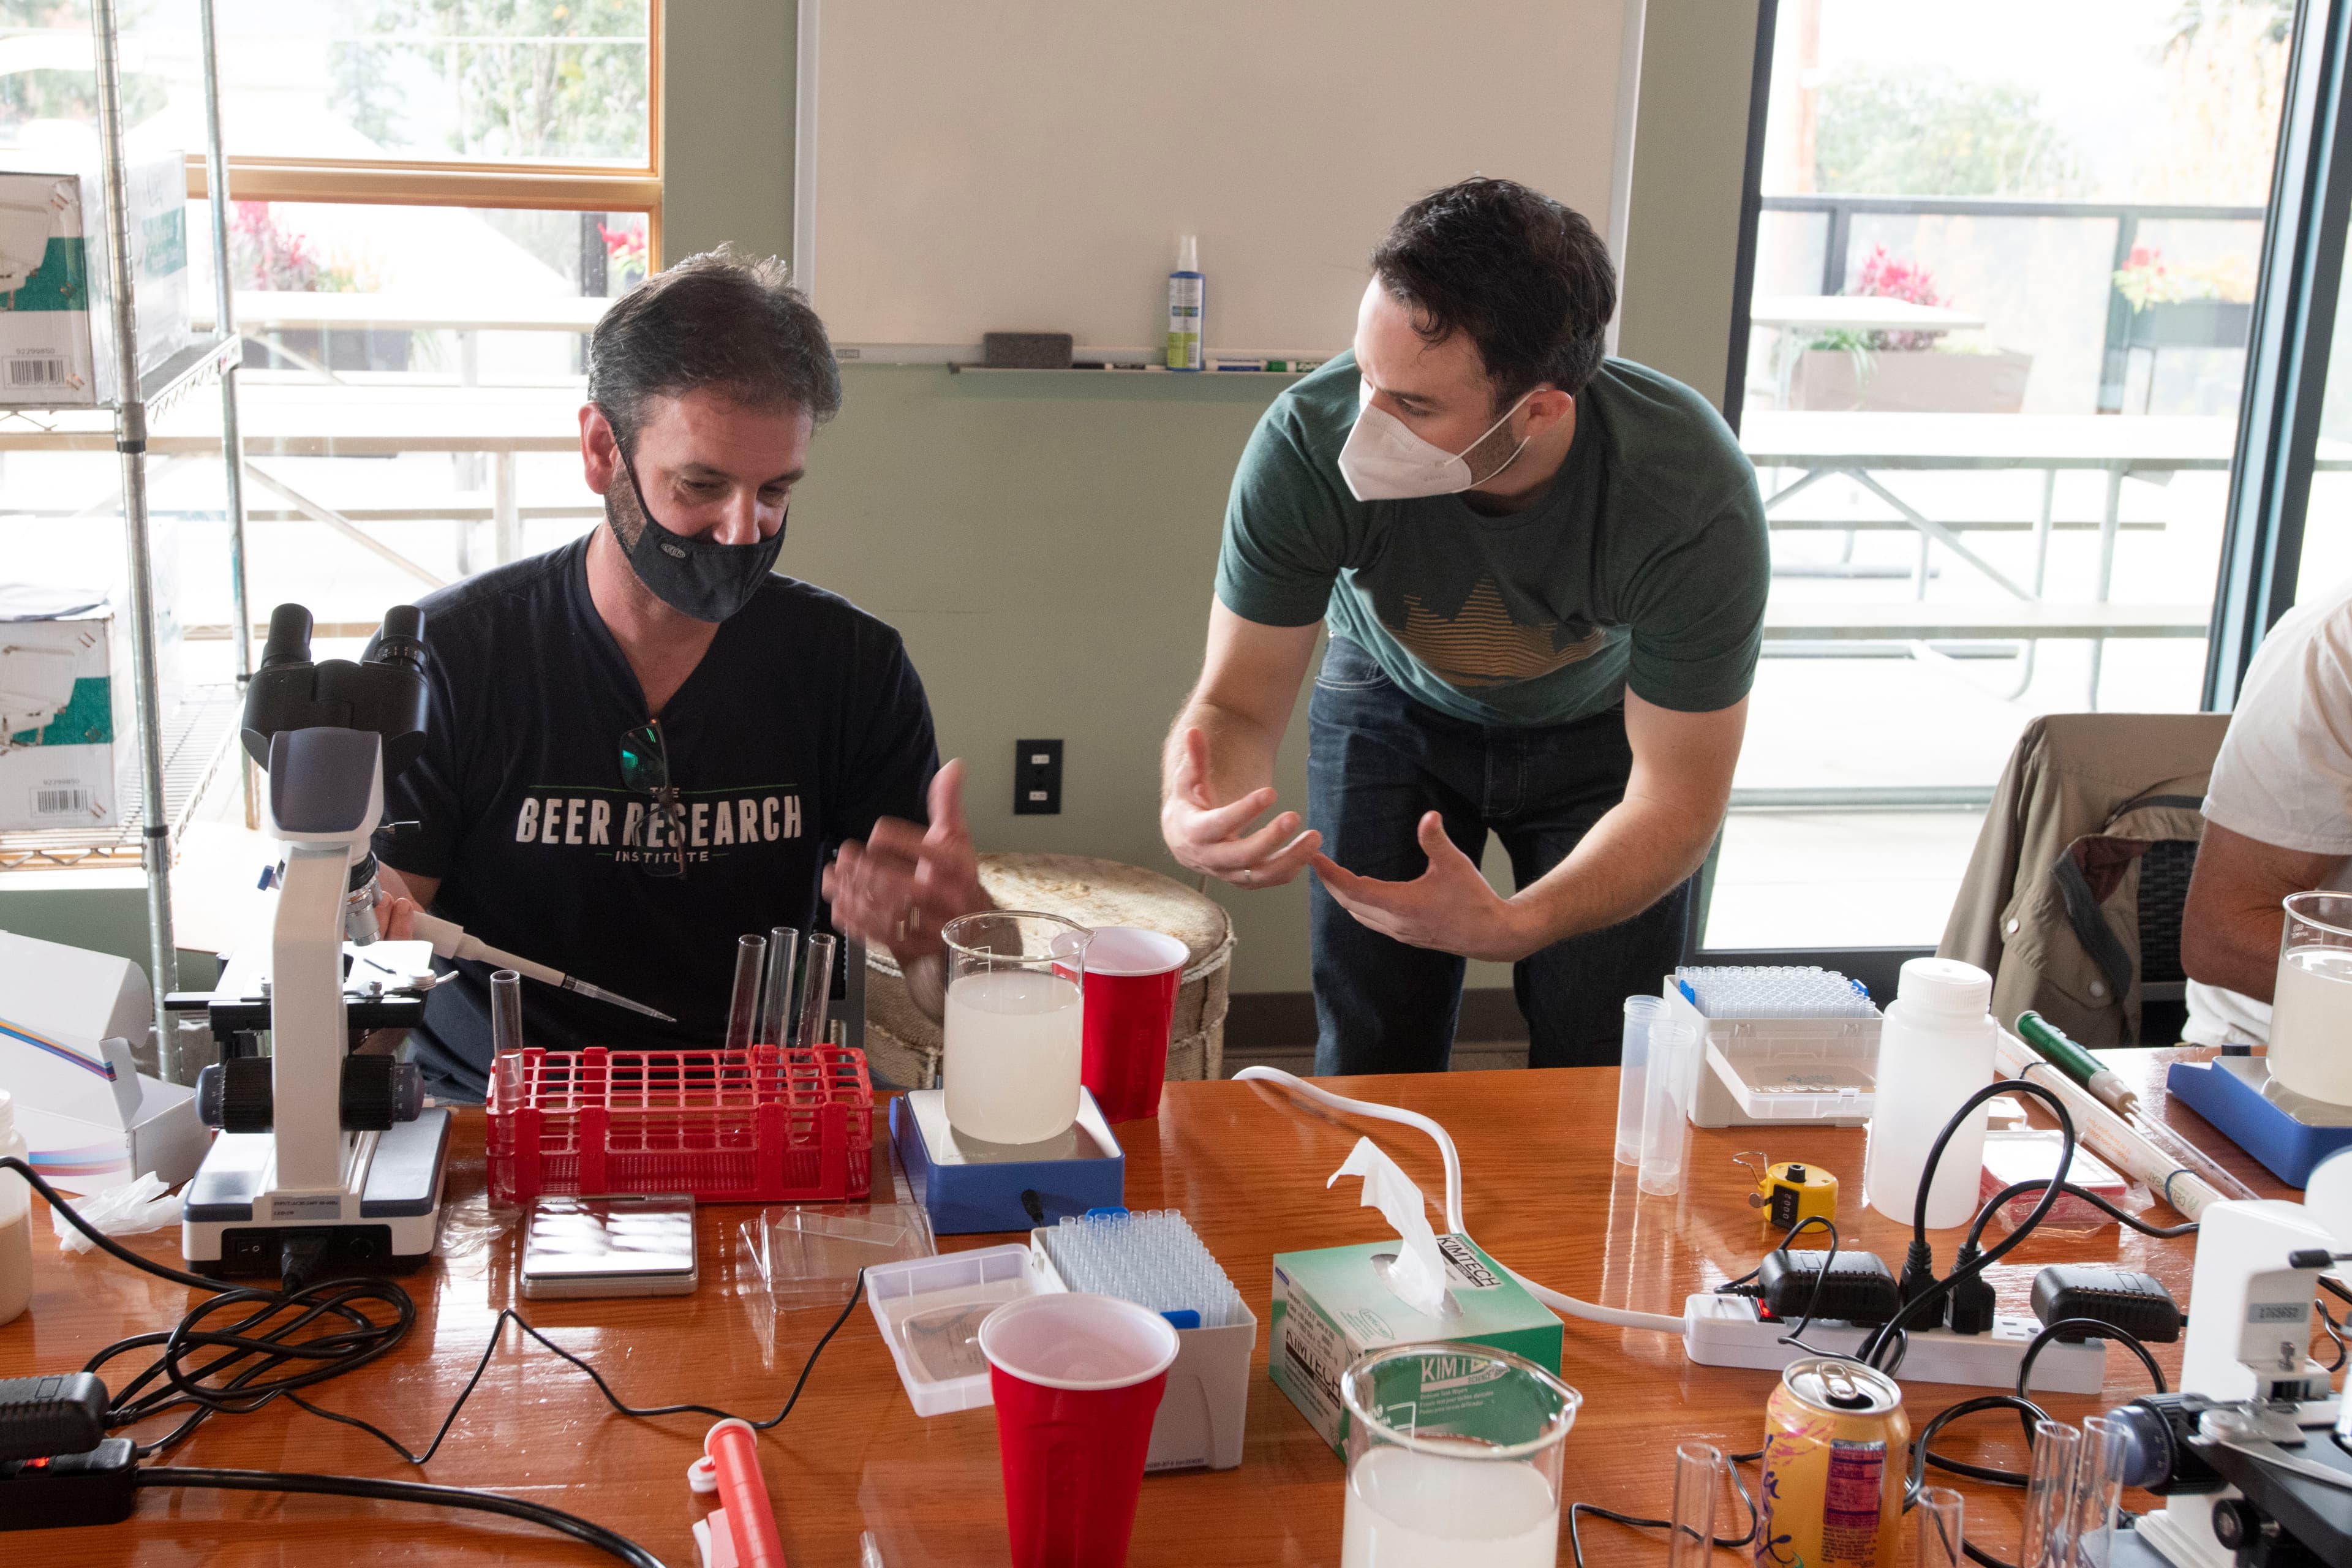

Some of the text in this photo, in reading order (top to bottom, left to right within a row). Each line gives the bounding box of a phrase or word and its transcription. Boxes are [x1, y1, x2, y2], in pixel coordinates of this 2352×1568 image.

[515, 795, 802, 847] BEER RESEARCH
[615, 850, 709, 864] INSTITUTE
[2146, 1171, 2187, 1207] CELLREAT
[1436, 1237, 1502, 1286] KIMTECH
